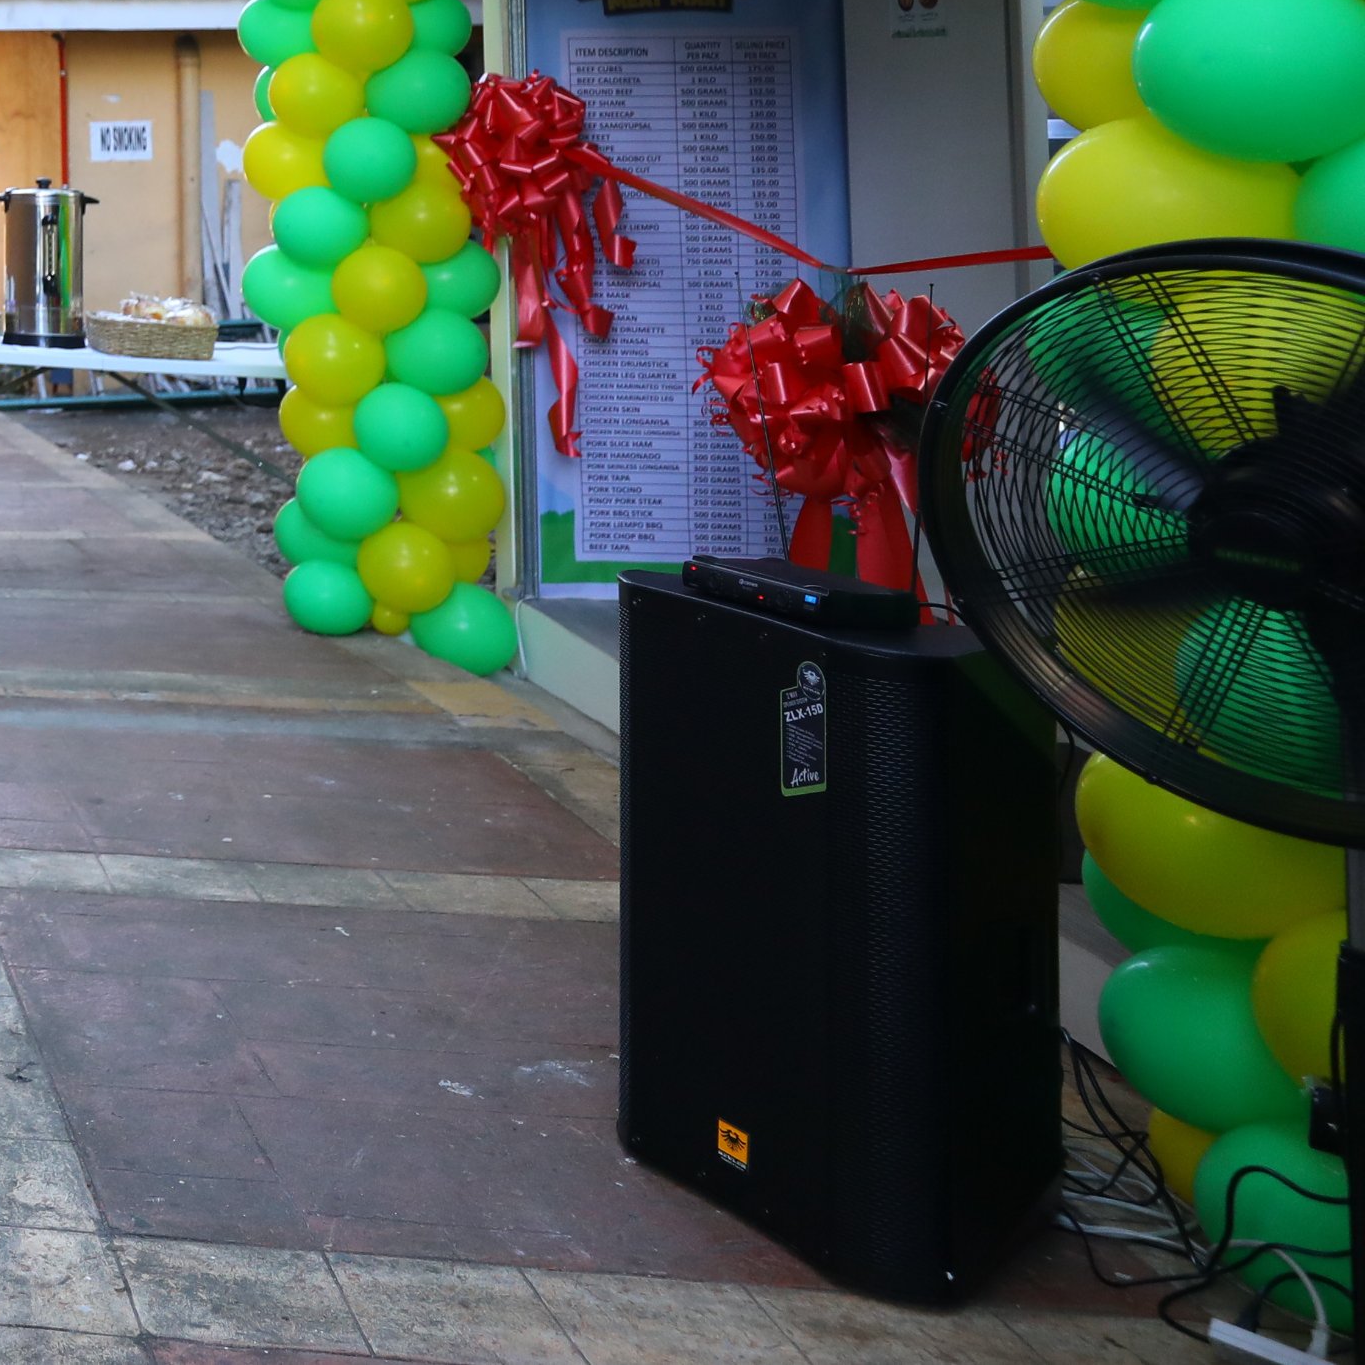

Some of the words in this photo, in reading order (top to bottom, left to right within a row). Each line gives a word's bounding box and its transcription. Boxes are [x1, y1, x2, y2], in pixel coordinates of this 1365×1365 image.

[685, 42, 720, 50] QUANTITY
[575, 48, 596, 57] ITEM
[598, 48, 649, 57] DESCRIPTION
[599, 122, 651, 130] SAMGYUPSAL
[100, 127, 110, 151] NO
[113, 126, 147, 151] SMOKING
[701, 190, 731, 198] GRAMS
[686, 235, 700, 243] 500
[702, 235, 732, 243] GRAMS
[686, 246, 700, 254] 500
[702, 246, 733, 254] GRAMS
[649, 269, 664, 277] CUT
[705, 292, 723, 300] KILO
[620, 326, 665, 334] DRUMETTE
[584, 360, 618, 368] CHICKEN
[620, 360, 669, 368] DRUMSTICK
[585, 417, 619, 425] CHICKEN
[622, 417, 670, 425] LONGANISA
[694, 442, 708, 450] 250
[710, 442, 739, 450] GRAMS
[783, 703, 824, 722] ZLX-15D
[790, 768, 820, 787] Active
